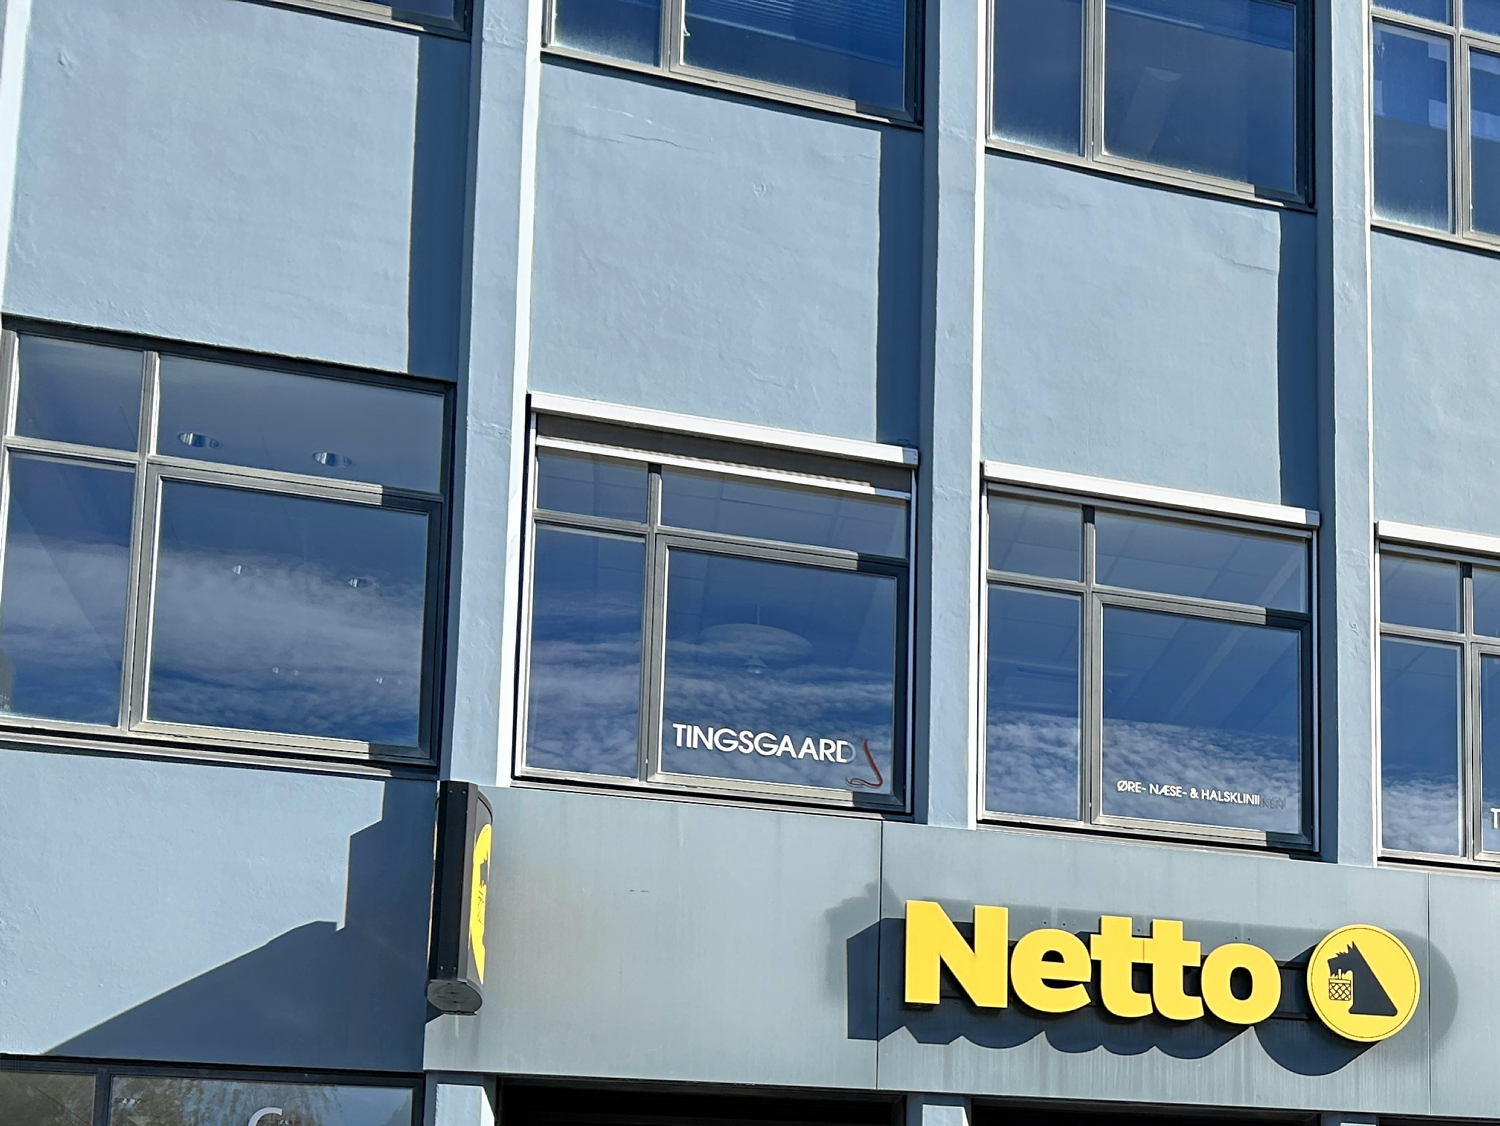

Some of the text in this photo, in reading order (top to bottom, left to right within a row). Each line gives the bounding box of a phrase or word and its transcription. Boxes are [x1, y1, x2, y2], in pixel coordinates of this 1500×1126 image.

[672, 722, 856, 763] TINGSGAARD
[1116, 780, 1146, 793] ØRE-
[1149, 782, 1187, 798] NÆSE-
[1190, 788, 1199, 799] &
[904, 899, 1281, 1024] Netto
